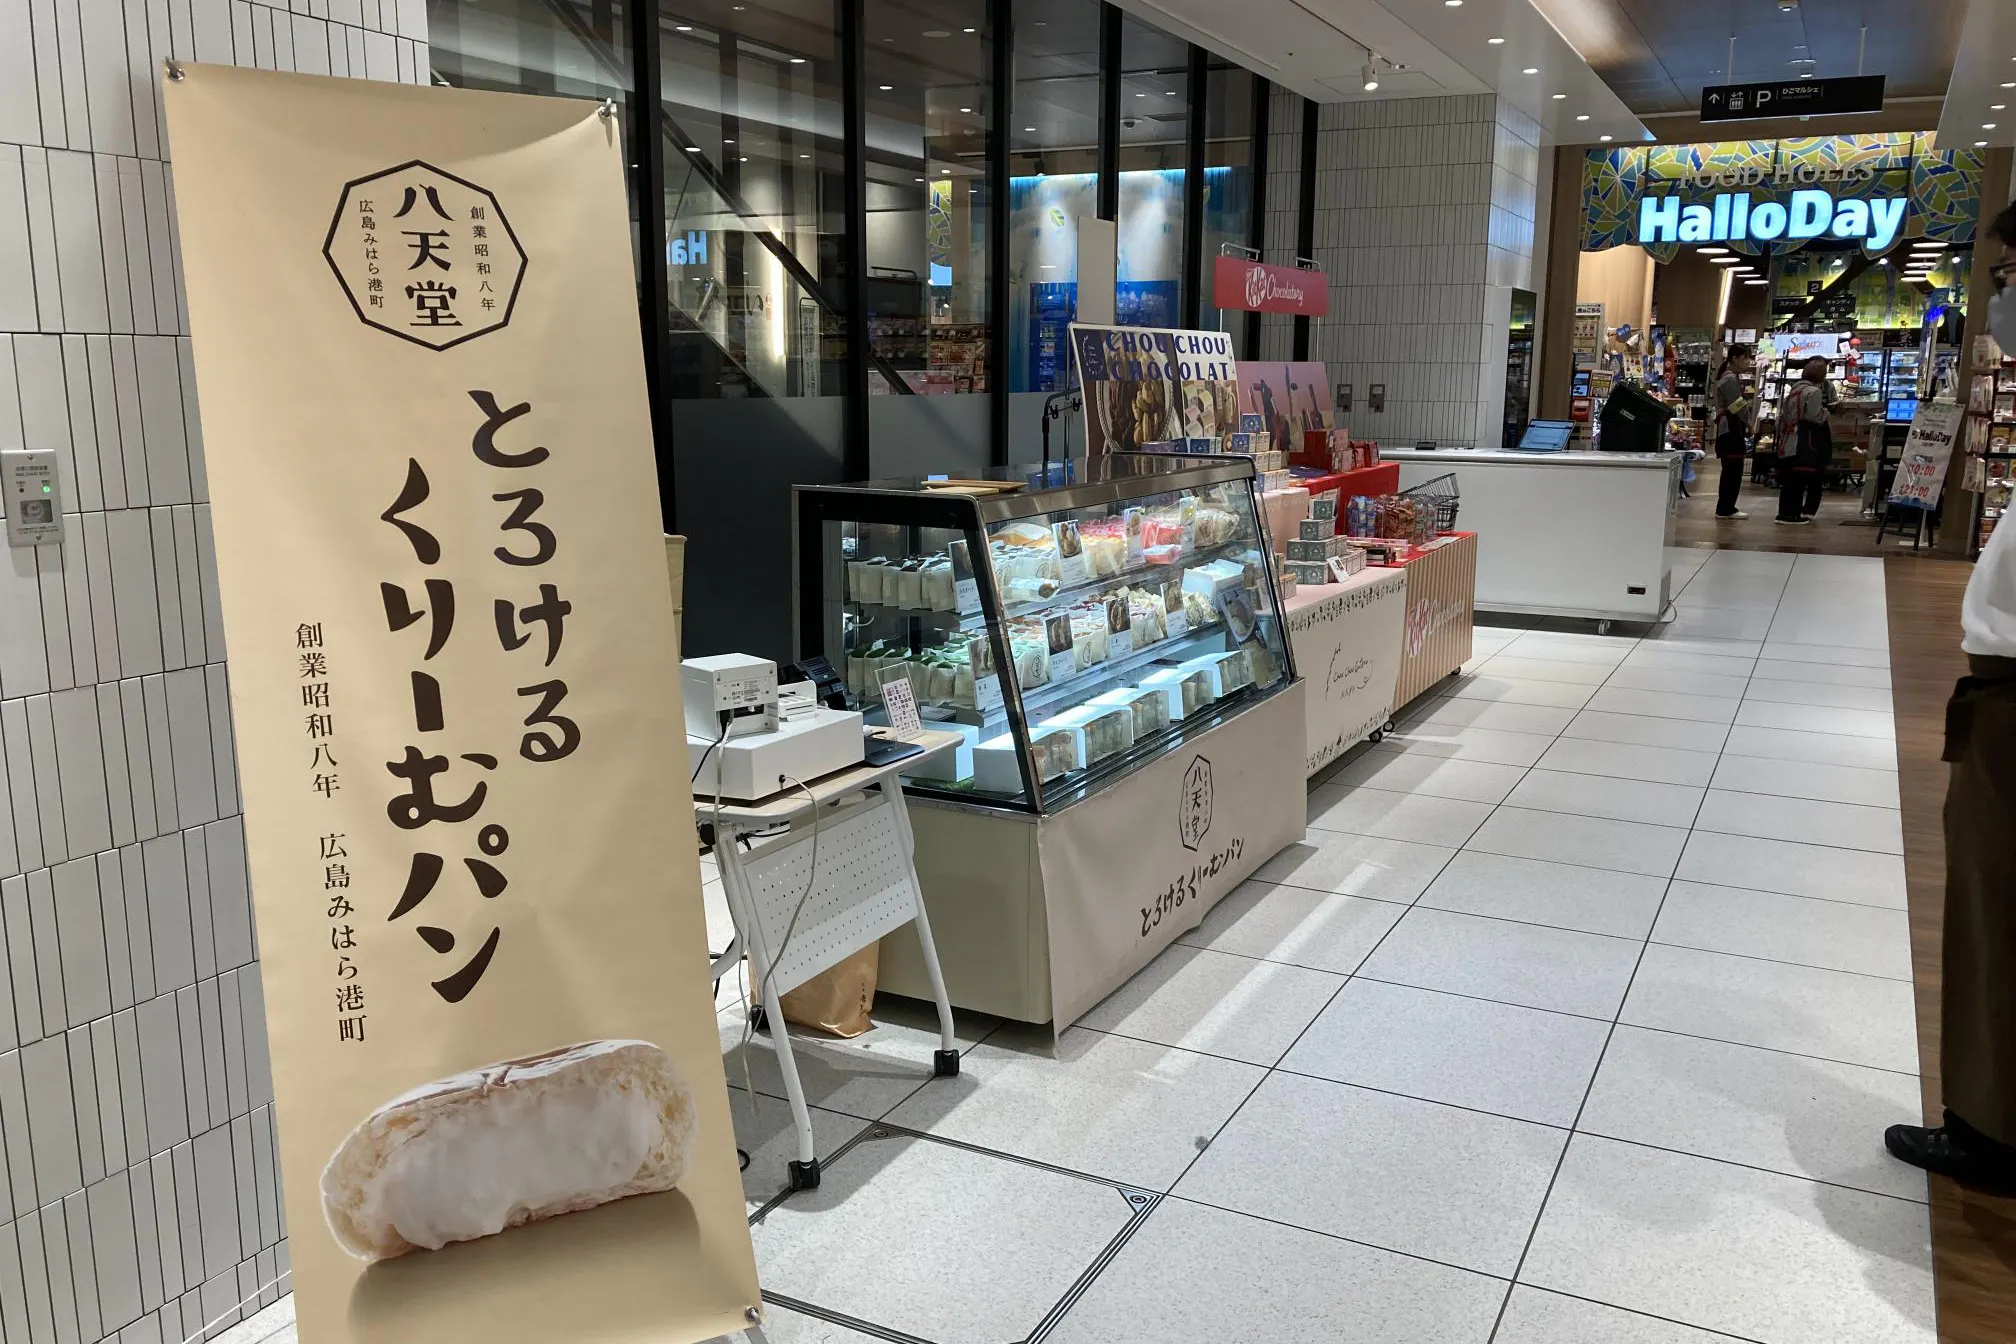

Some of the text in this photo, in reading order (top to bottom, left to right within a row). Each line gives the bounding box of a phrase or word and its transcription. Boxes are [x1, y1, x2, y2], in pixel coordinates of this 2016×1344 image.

[1756, 90, 1772, 108] P
[359, 199, 384, 309] 広島みはら港町
[392, 183, 463, 327] 八天堂
[1638, 189, 1908, 251] HalloDay
[470, 205, 496, 313] 創業昭和八年
[1266, 273, 1304, 307] Chocolatory
[1104, 331, 1168, 354] CHOU
[1174, 335, 1226, 355] CHOU
[1110, 360, 1230, 381] CHOCOLAT
[1918, 429, 1953, 446] HalloDay
[467, 389, 581, 763] とろける
[380, 457, 510, 1004] くりーむパン
[295, 622, 367, 1043] 創業昭和八年 広島みはら港町
[1191, 766, 1202, 843] 八天堂
